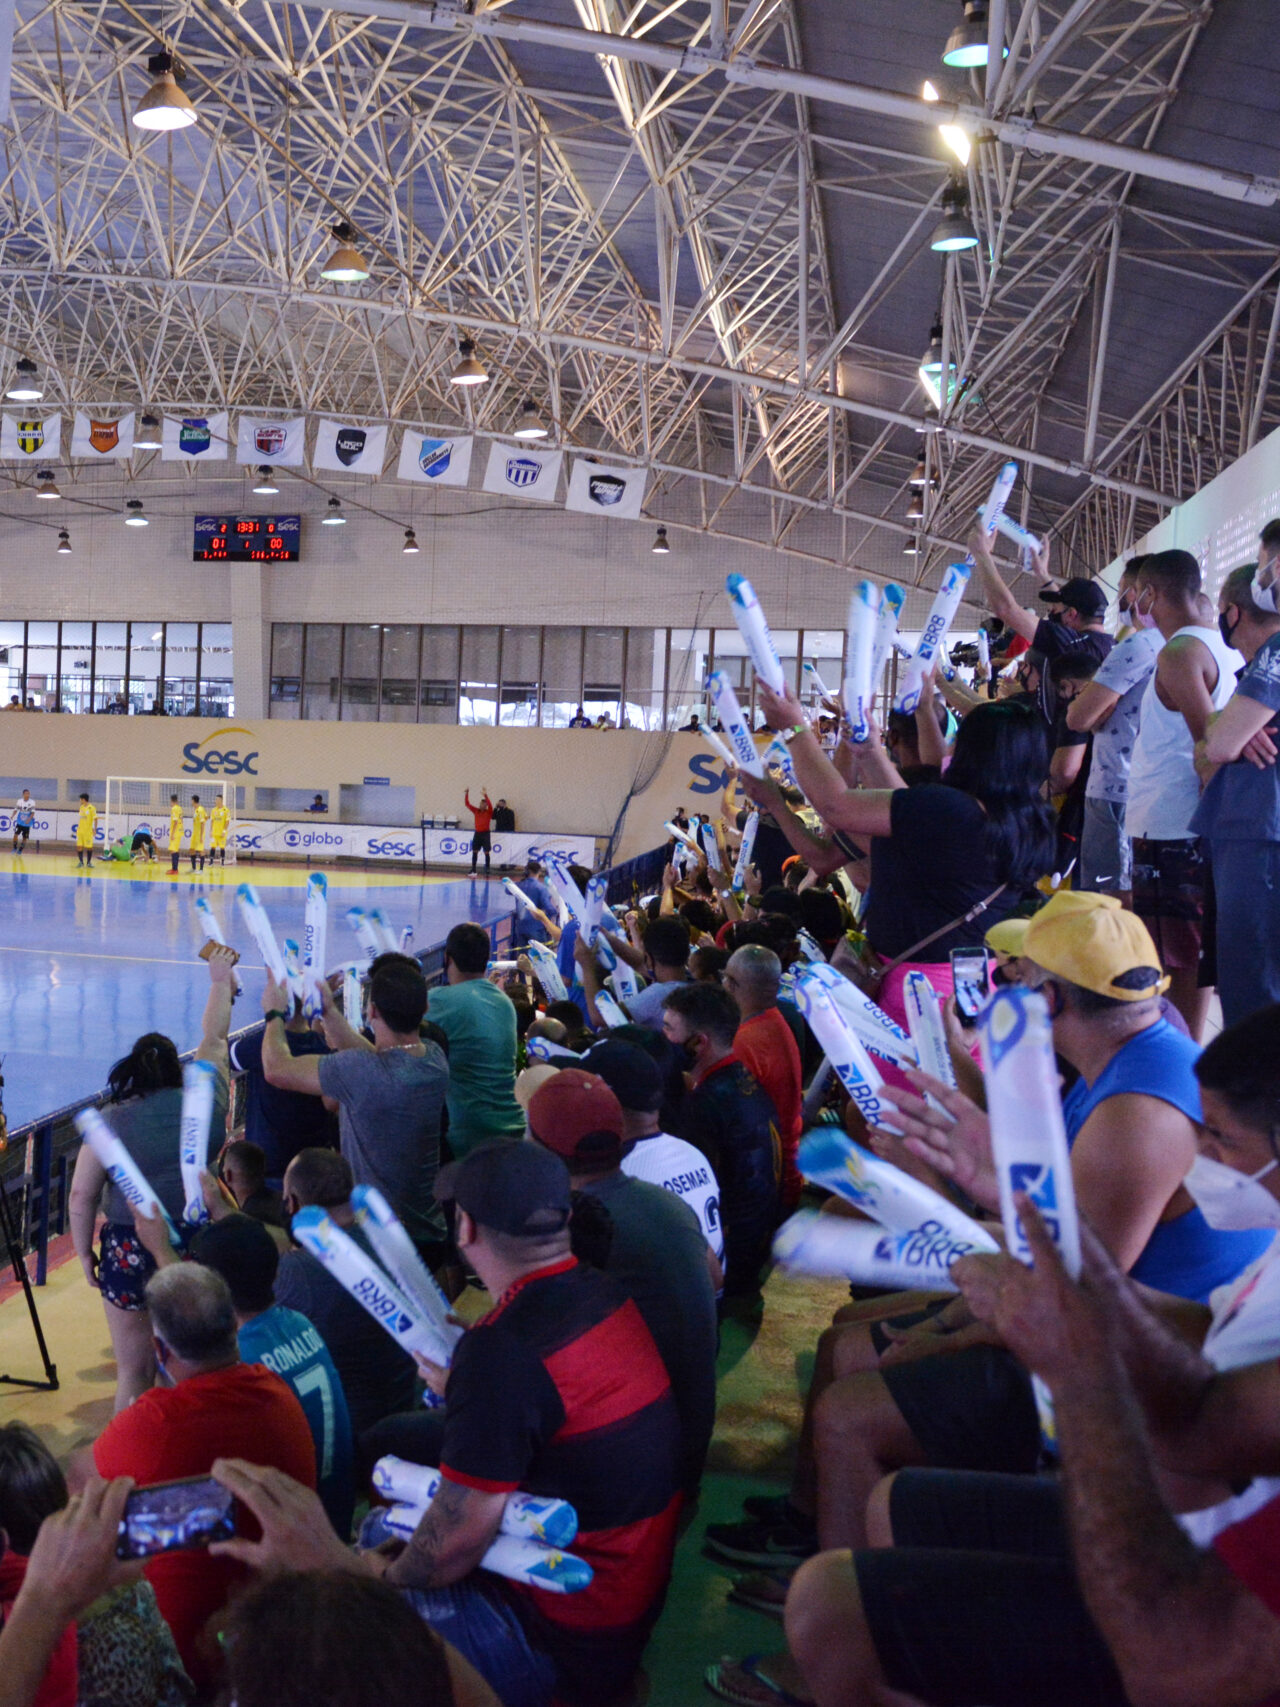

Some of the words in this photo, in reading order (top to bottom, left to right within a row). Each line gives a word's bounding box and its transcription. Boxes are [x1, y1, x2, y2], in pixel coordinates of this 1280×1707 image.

[195, 522, 217, 531] Sesc
[237, 521, 260, 533] 13:31
[277, 522, 299, 531] Sesc
[212, 537, 225, 549] 01
[270, 537, 282, 549] 00
[923, 614, 946, 645] BRB
[181, 742, 259, 775] Sesc
[734, 736, 755, 763] BRB
[302, 830, 343, 847] globo
[368, 837, 416, 857] Sesc
[353, 1277, 396, 1316] BRB
[293, 1363, 335, 1479] 7
